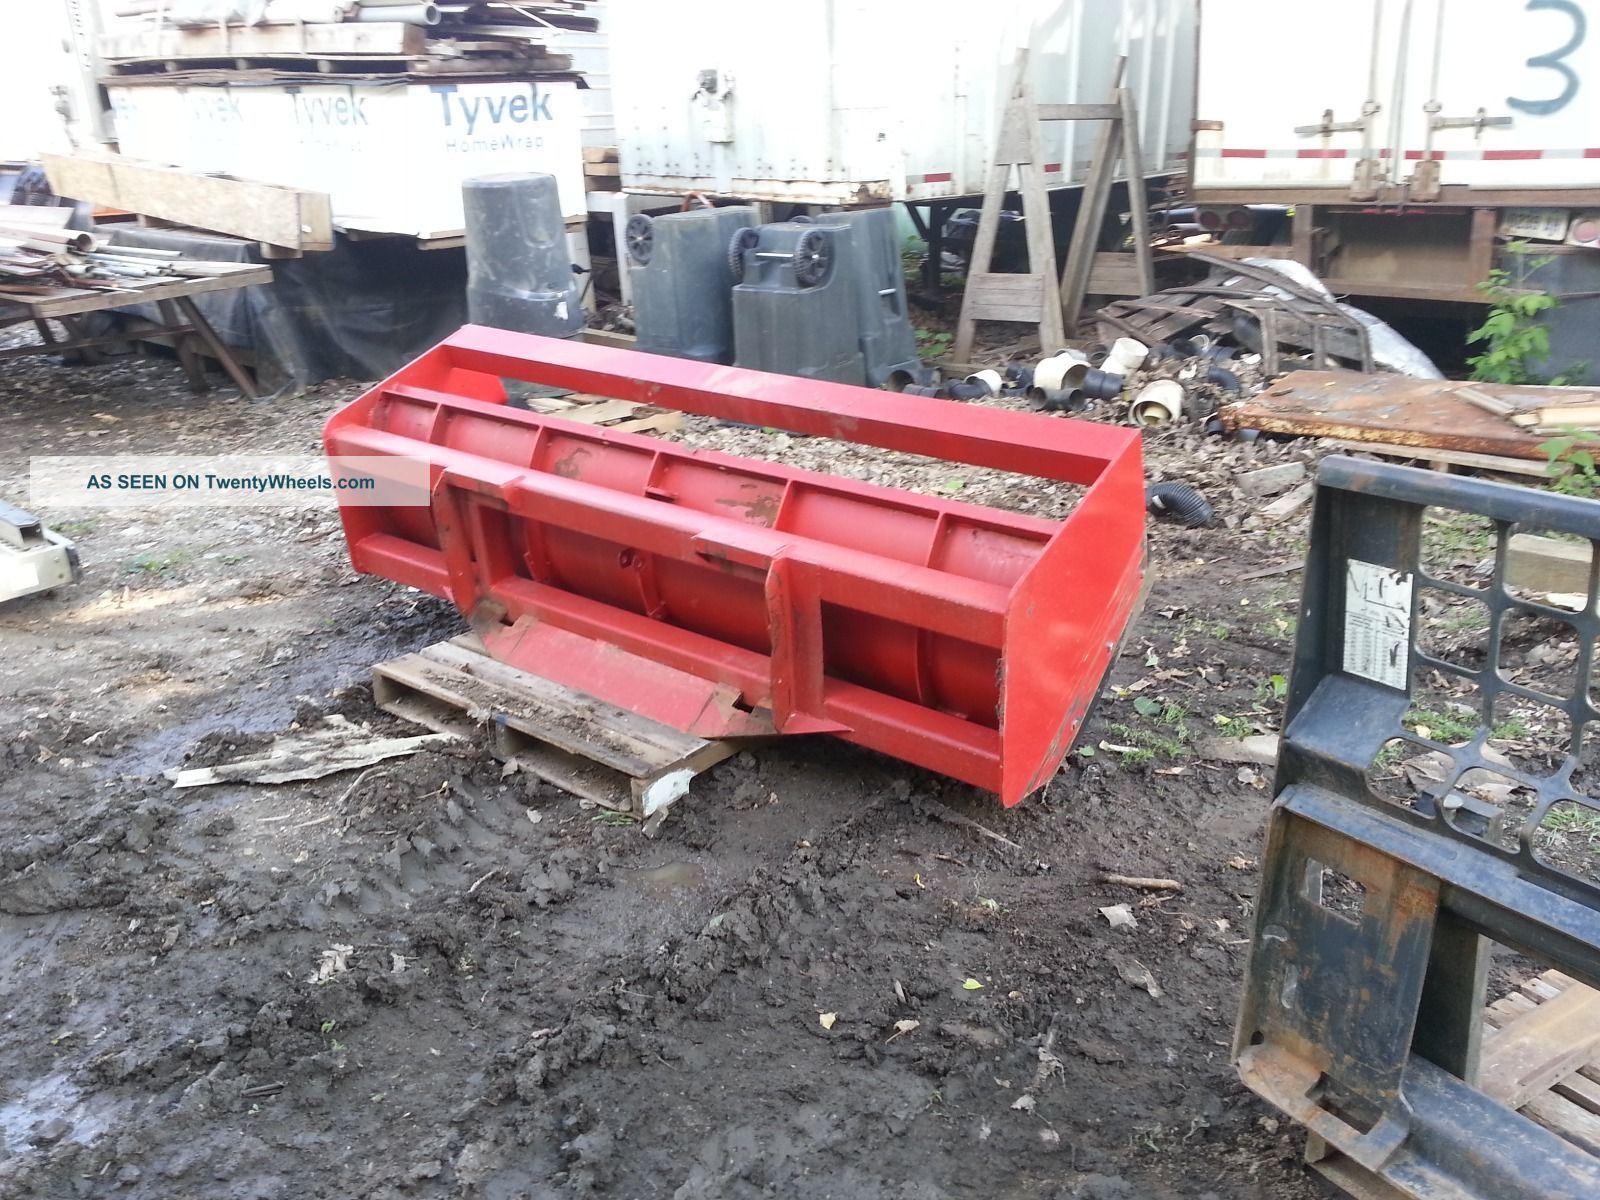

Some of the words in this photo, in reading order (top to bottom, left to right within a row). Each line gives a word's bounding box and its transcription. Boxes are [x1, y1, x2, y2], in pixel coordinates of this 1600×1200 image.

[1506, 0, 1588, 116] 3
[283, 86, 369, 129] Tyvek
[430, 82, 554, 135] Tyvek
[446, 134, 544, 153] HomeWrap
